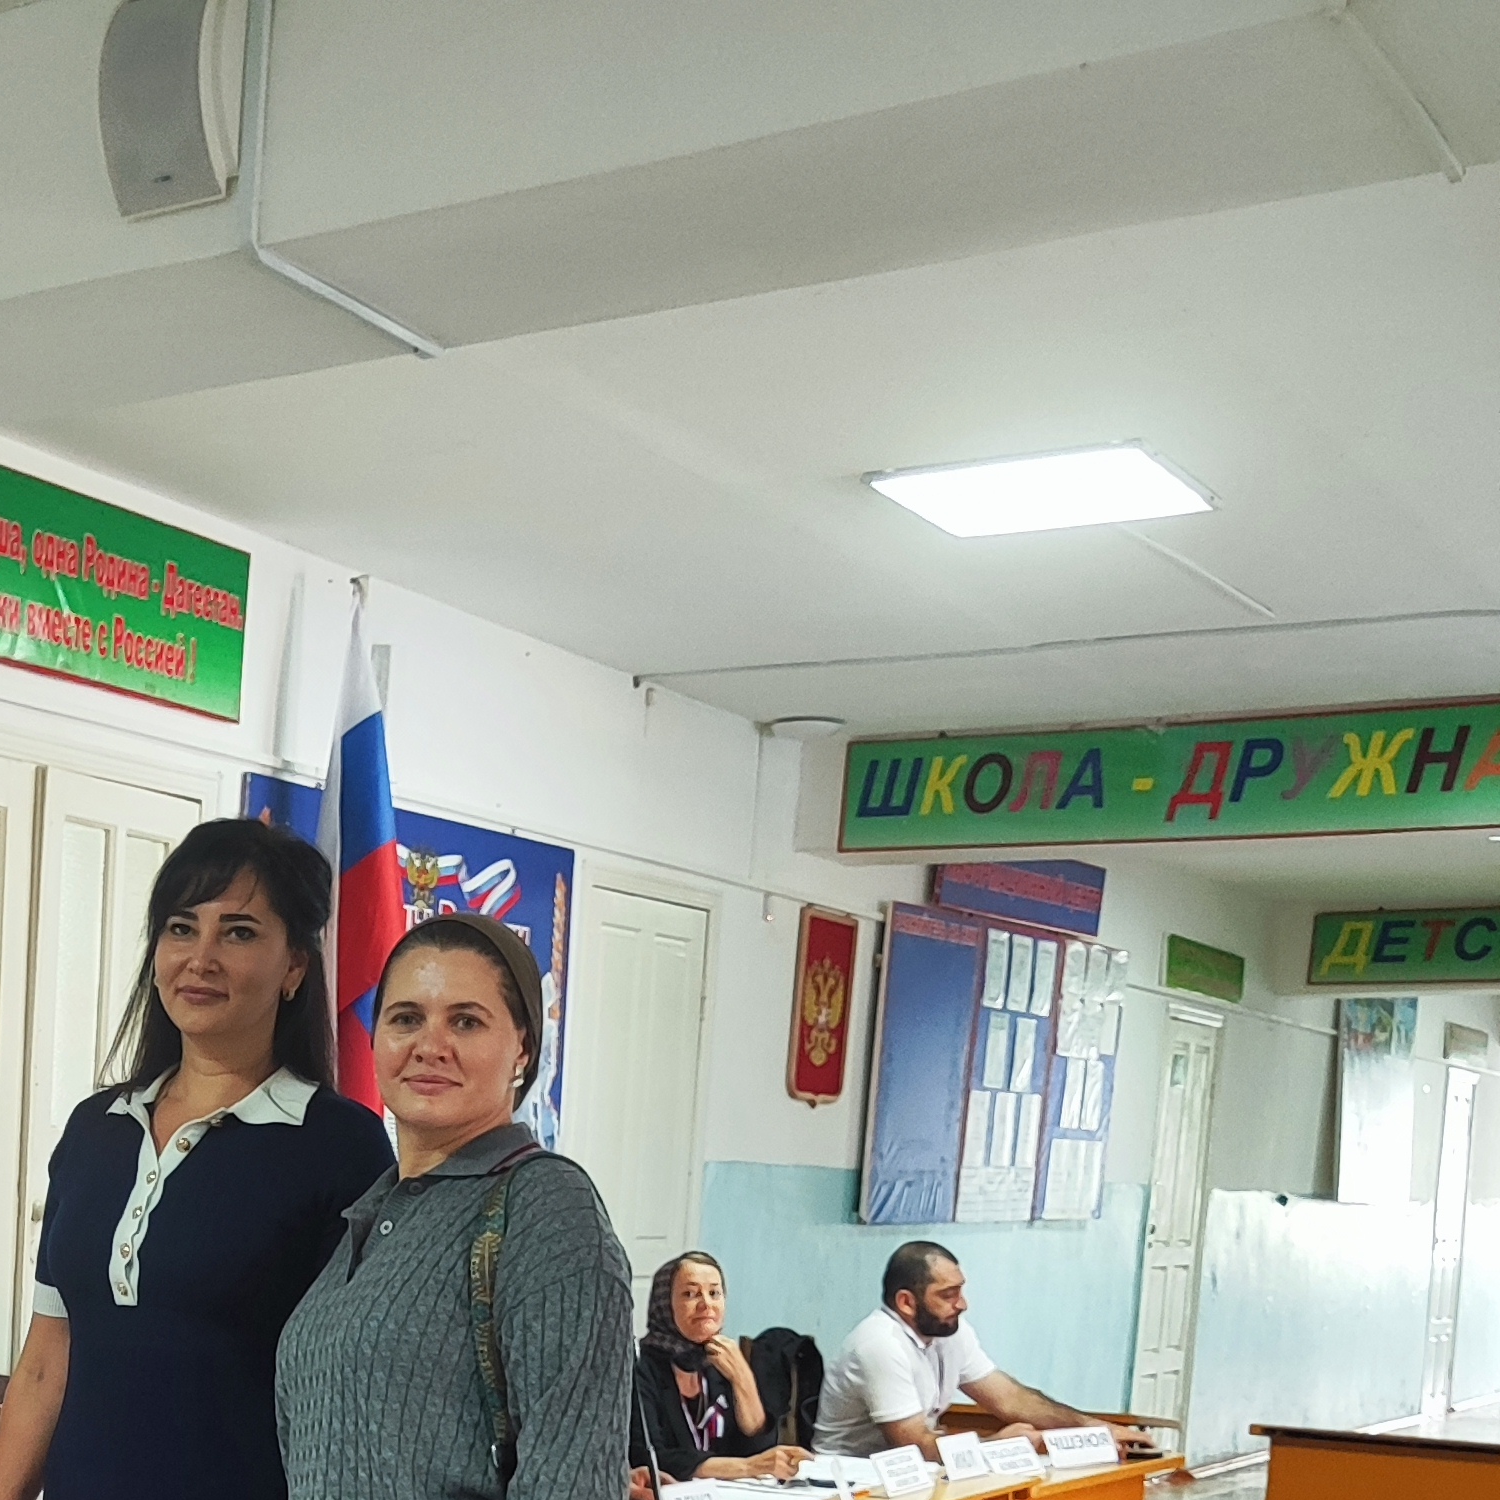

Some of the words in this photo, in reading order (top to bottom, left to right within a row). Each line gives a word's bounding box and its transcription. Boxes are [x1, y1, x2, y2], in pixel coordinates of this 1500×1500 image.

[32, 529, 79, 581] одна
[82, 533, 150, 600] Родина
[26, 600, 93, 655] вместе
[96, 621, 108, 659] с
[856, 748, 1104, 818] ШКОЛА
[1320, 917, 1498, 976] ДЕТС
